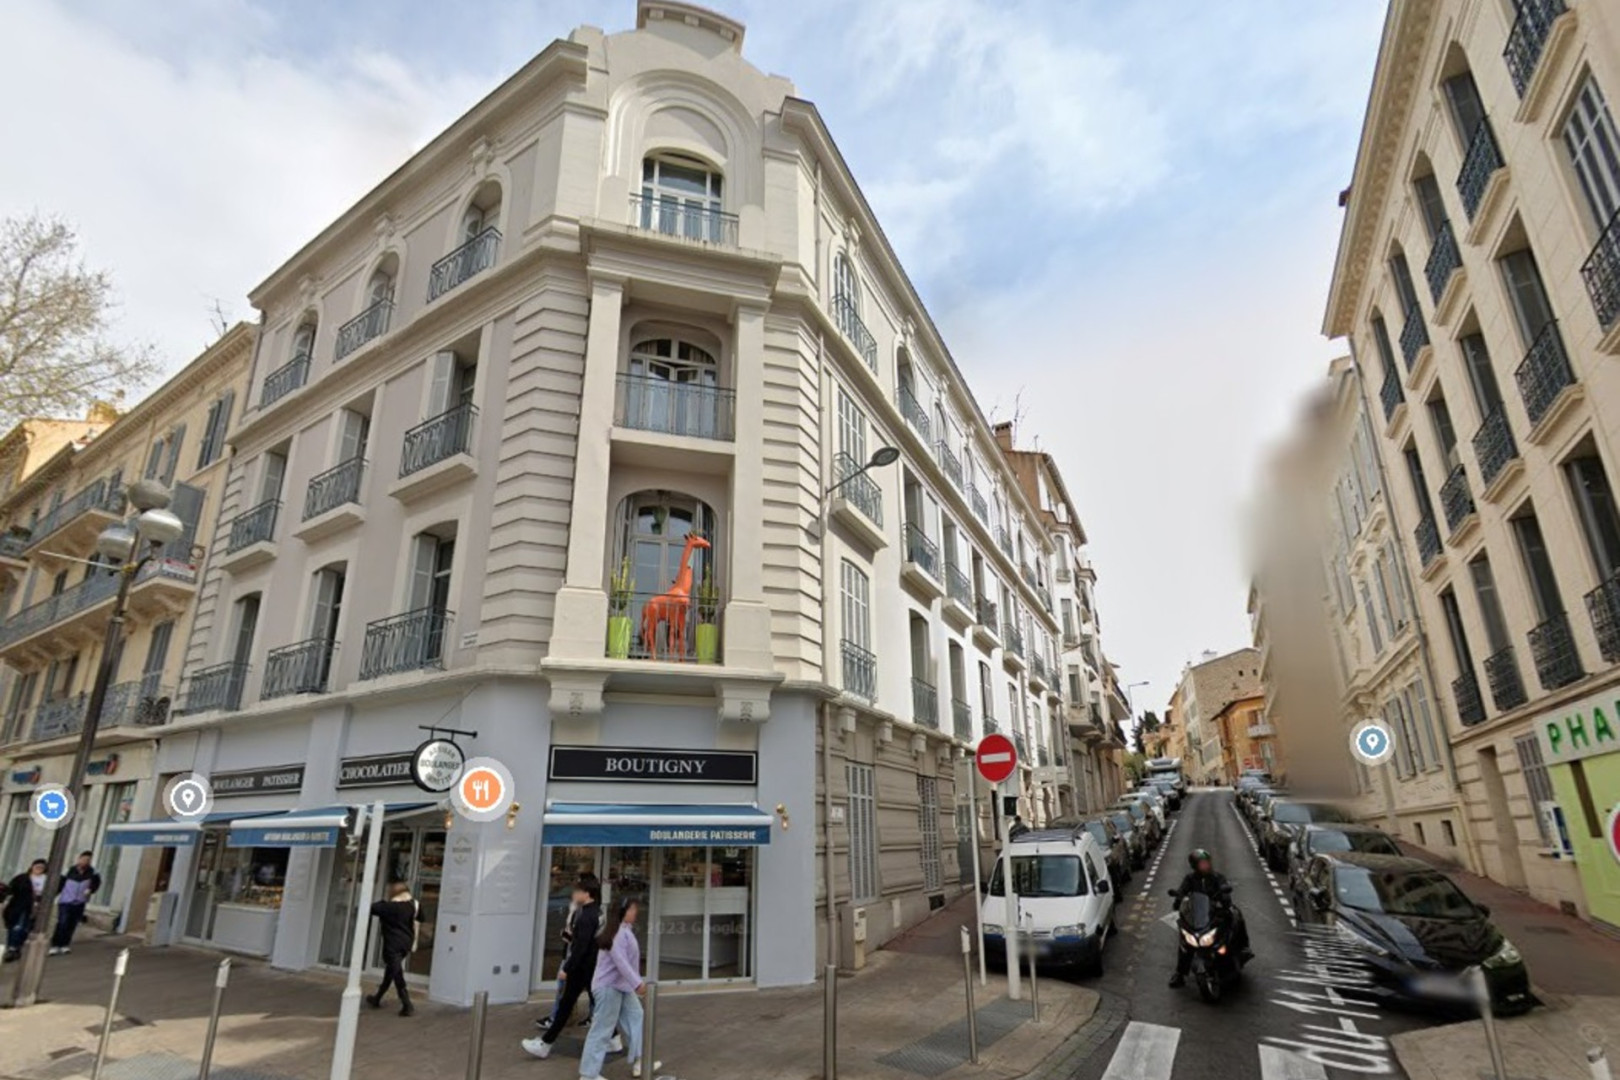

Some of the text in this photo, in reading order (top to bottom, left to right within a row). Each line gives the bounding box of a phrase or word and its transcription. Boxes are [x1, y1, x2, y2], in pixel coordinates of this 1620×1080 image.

[340, 762, 411, 780] CHOCOLATIER
[605, 757, 706, 774] BOUTIGNY
[650, 829, 757, 841] BOULANGERIE PATISSERIE
